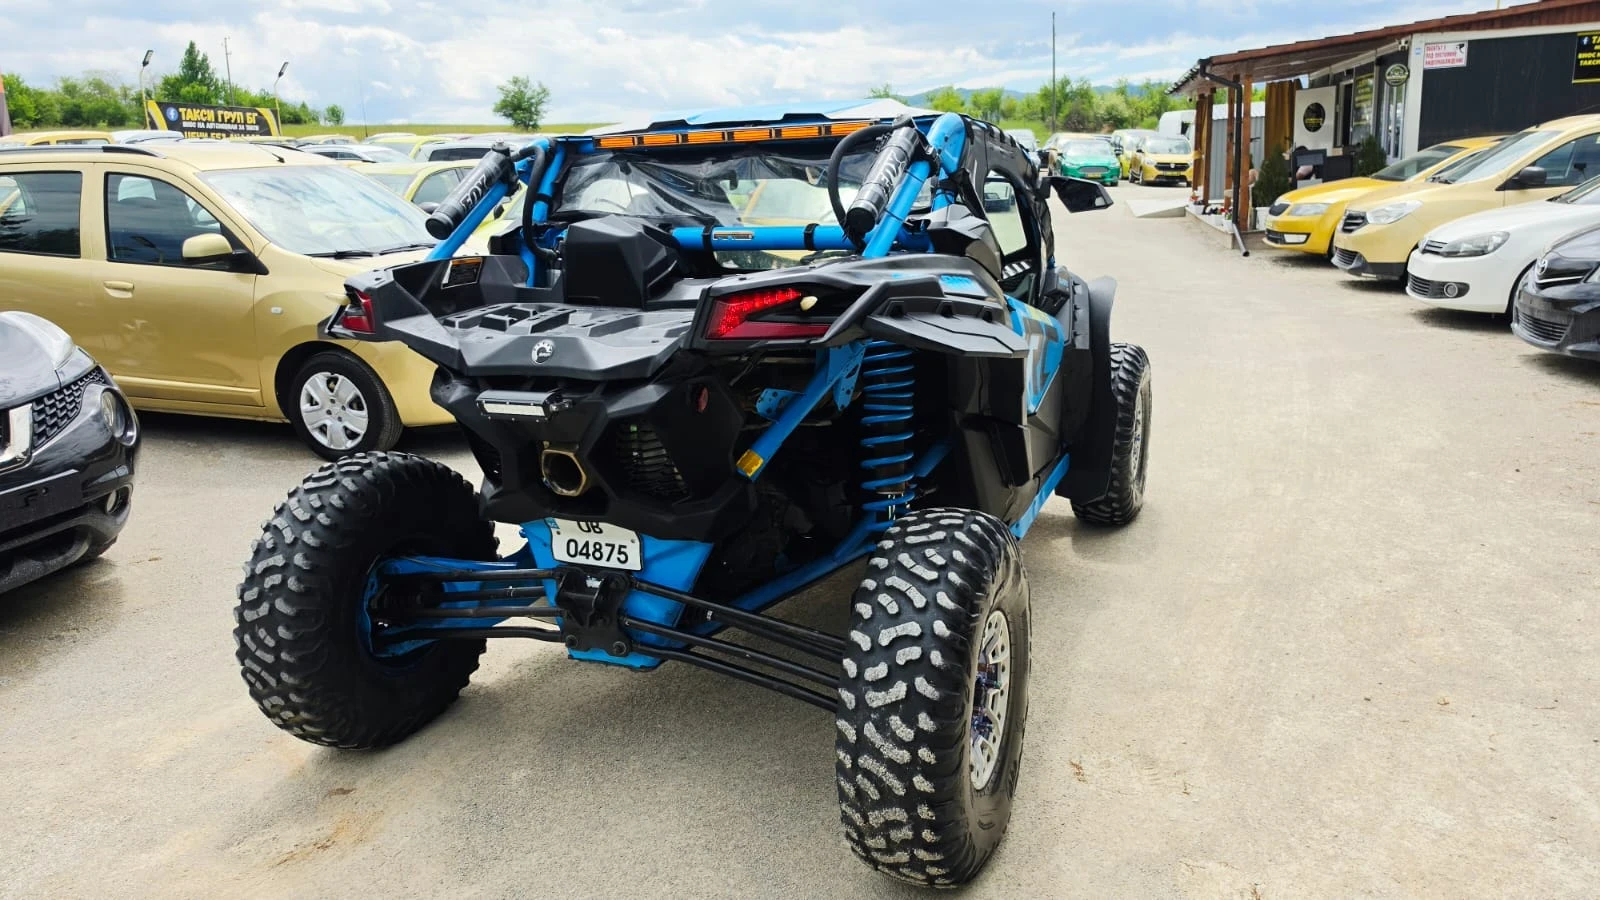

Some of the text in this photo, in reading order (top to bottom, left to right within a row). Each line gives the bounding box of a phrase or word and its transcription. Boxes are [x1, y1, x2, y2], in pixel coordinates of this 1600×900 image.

[179, 108, 258, 125] ТАКСИ ГРУП БГ
[881, 150, 907, 192] FOX
[460, 174, 490, 210] FOX
[566, 538, 629, 565] 04875
